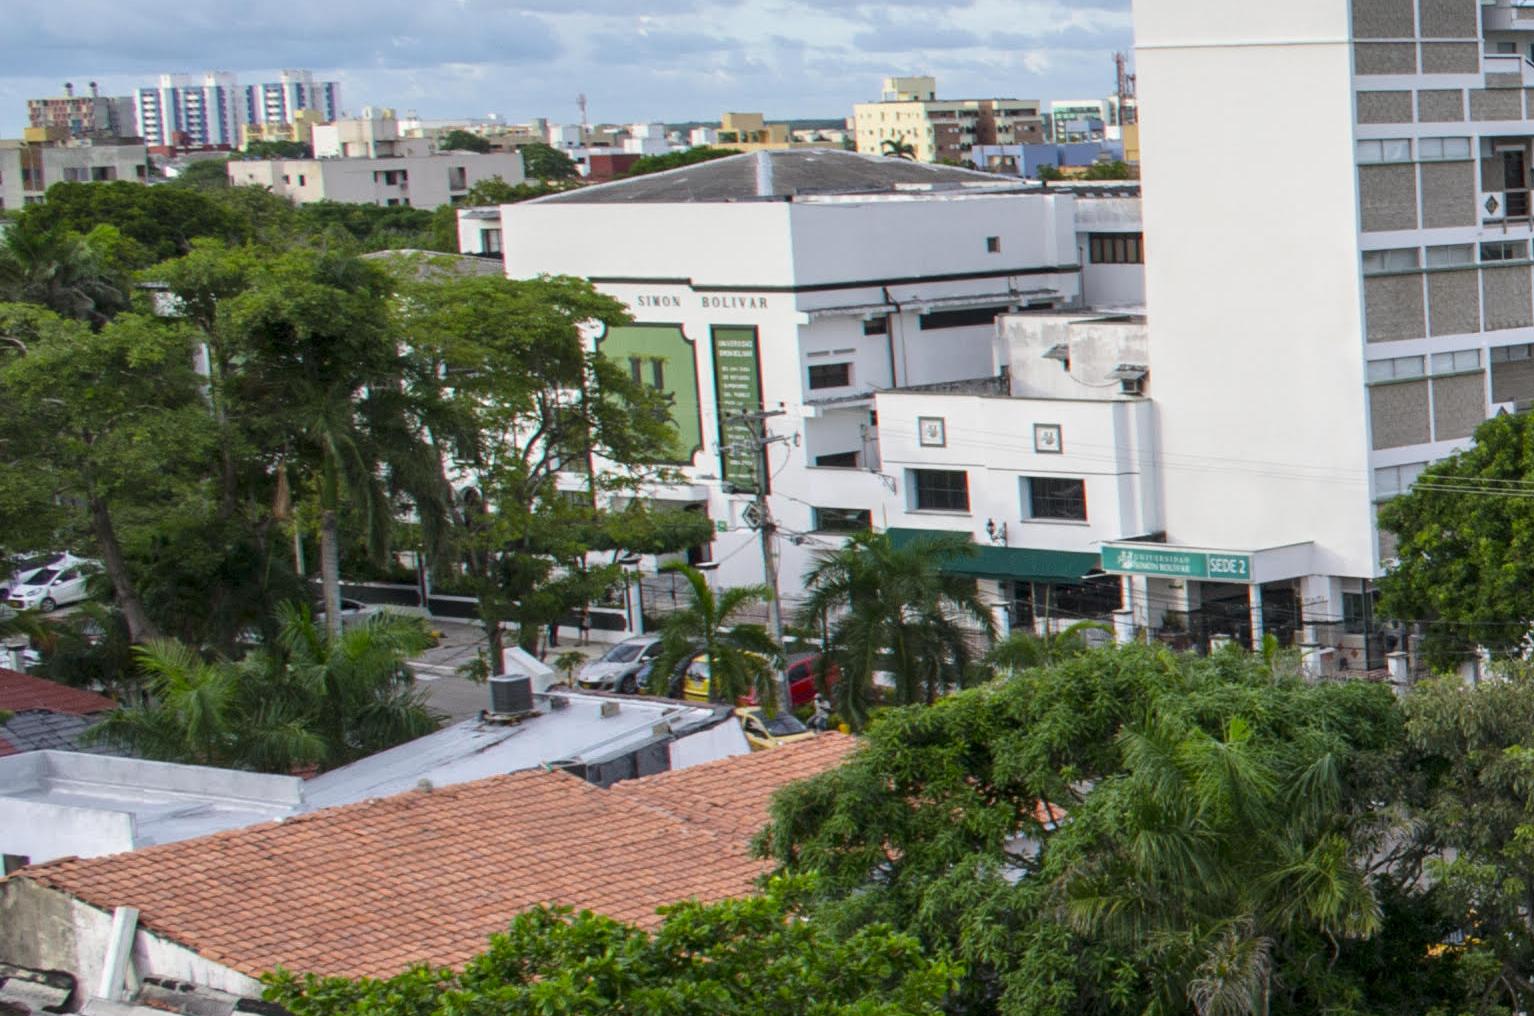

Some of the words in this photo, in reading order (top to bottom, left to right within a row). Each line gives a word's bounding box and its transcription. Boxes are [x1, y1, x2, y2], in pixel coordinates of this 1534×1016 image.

[638, 295, 681, 307] SIMON
[702, 296, 768, 309] BOLIVAR
[1210, 558, 1237, 574] SEDE
[1238, 559, 1246, 574] 2
